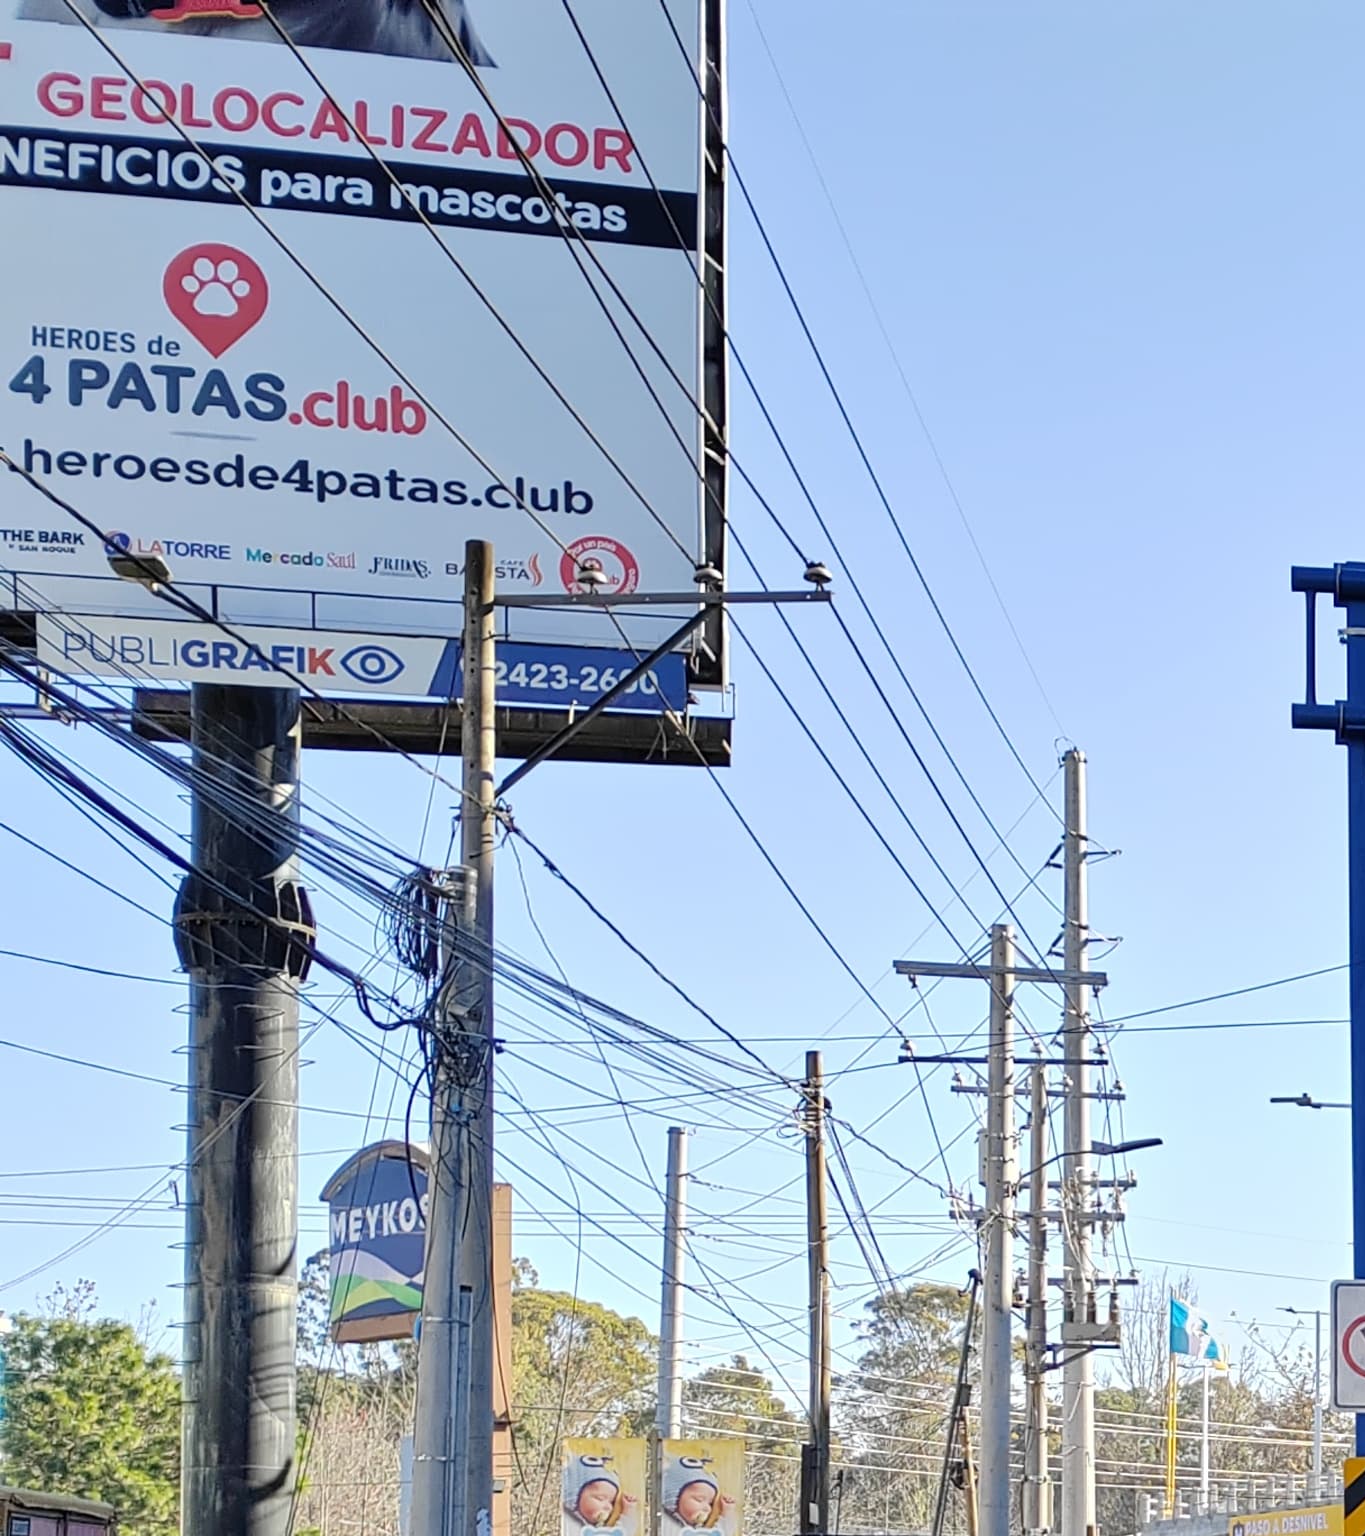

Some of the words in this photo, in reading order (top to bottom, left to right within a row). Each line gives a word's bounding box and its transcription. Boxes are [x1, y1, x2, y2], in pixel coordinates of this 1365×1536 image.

[36, 71, 634, 174] GEOLOCALIZADOR
[260, 168, 373, 206] para
[391, 183, 628, 232] mascotas
[31, 325, 136, 354] HEROES
[147, 335, 181, 357] de
[8, 354, 52, 405] 4
[67, 357, 427, 435] PATAS.club
[0, 529, 34, 542] THE
[38, 530, 85, 546] BARK
[446, 562, 530, 581] BSTA
[62, 630, 336, 677] PUBLIGRAFIK
[1245, 1519, 1270, 1536] PASO
[1282, 1512, 1329, 1534] DESNIVEL
